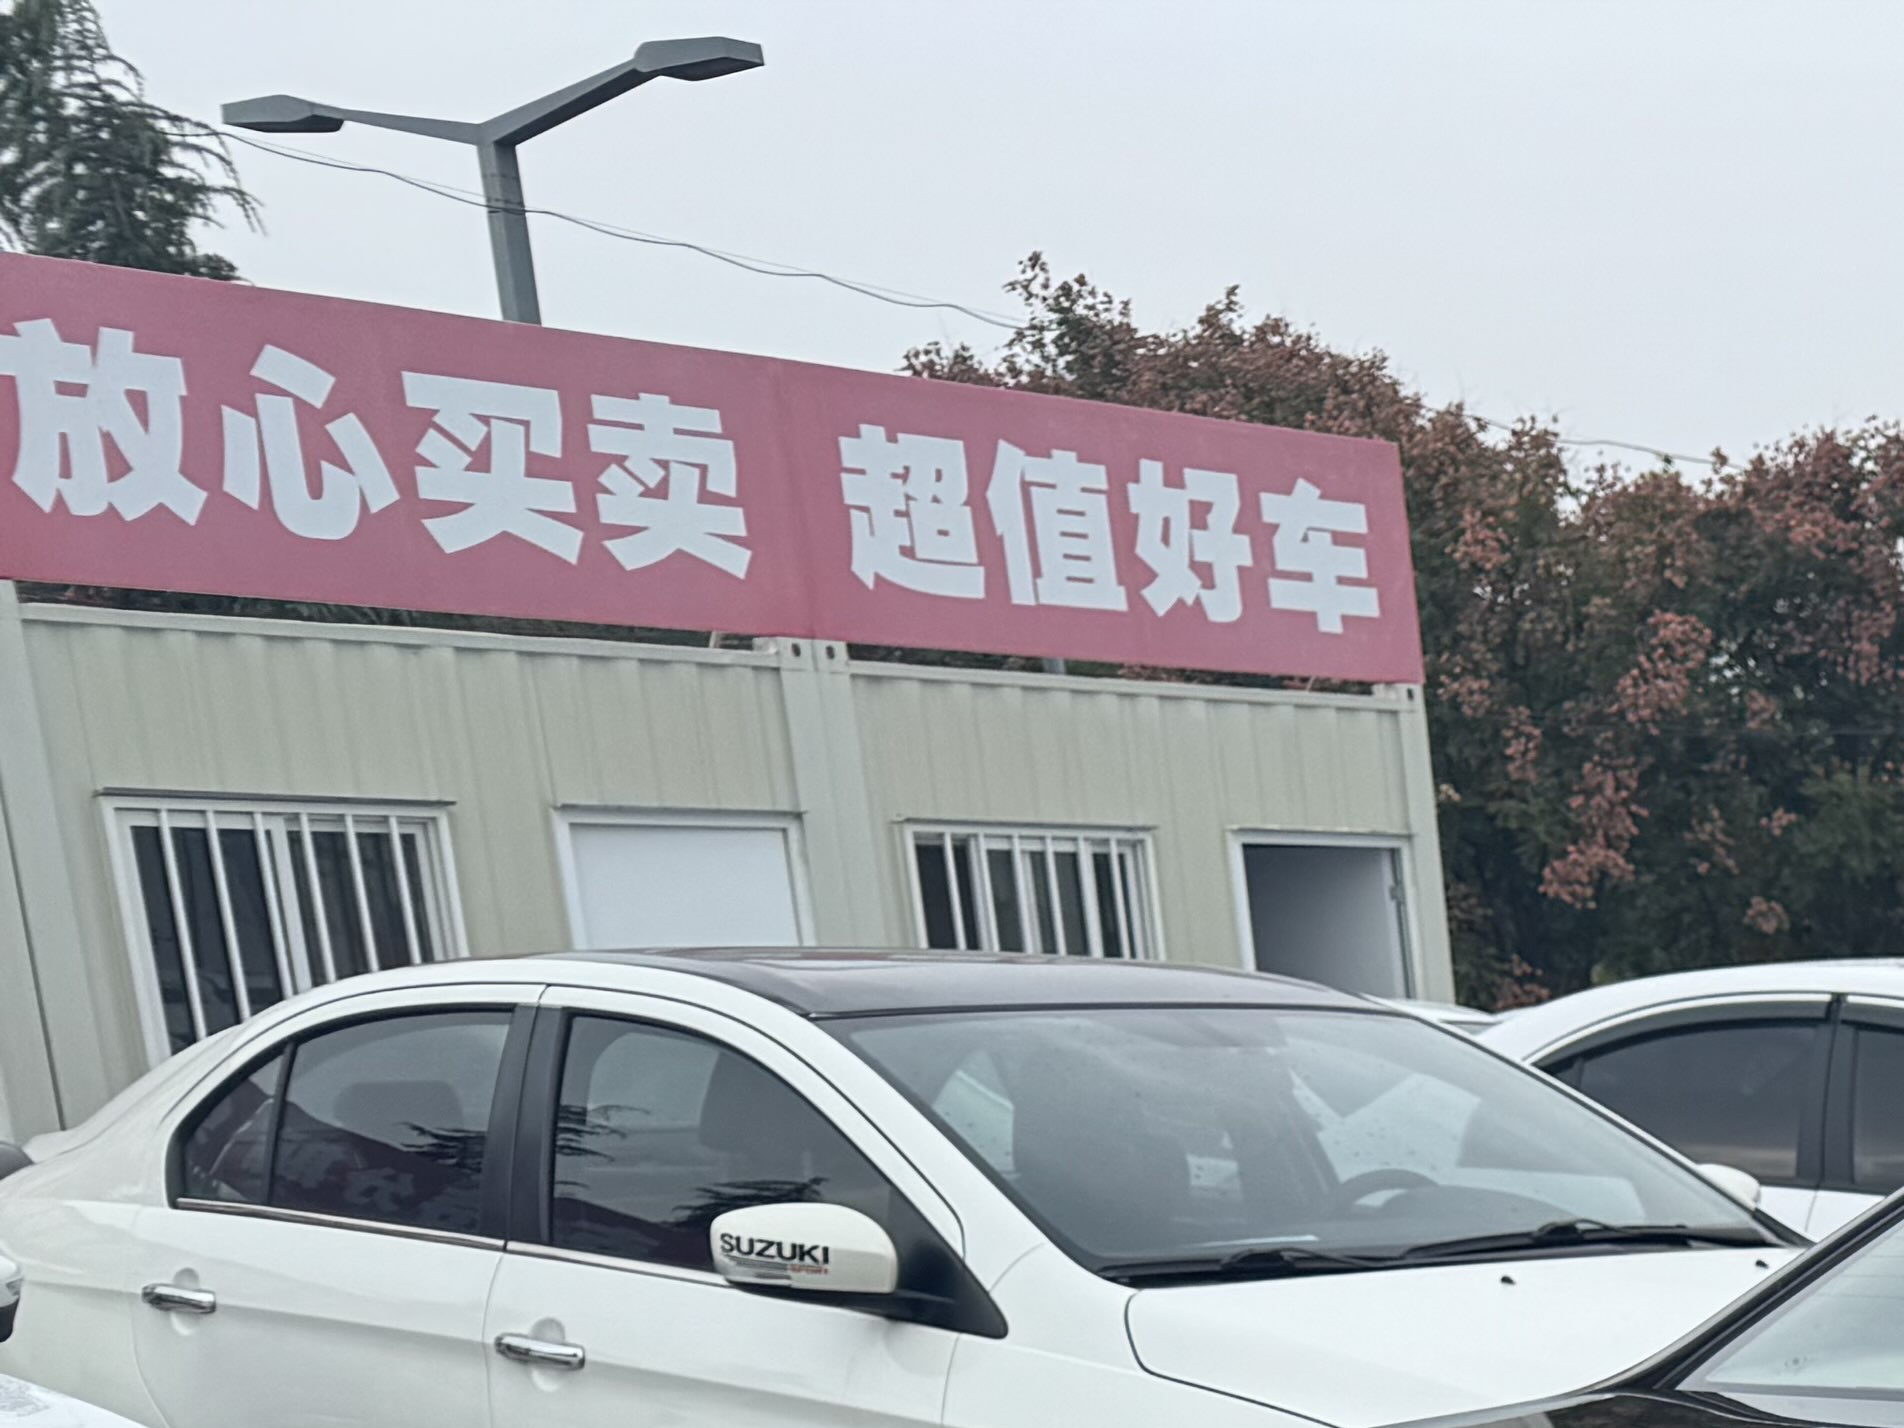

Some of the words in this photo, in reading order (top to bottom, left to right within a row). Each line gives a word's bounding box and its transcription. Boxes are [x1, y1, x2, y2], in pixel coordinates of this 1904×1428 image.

[0, 318, 752, 580] 放心买卖
[837, 422, 1380, 635] 超值好车
[720, 1233, 830, 1264] SUZUKI
